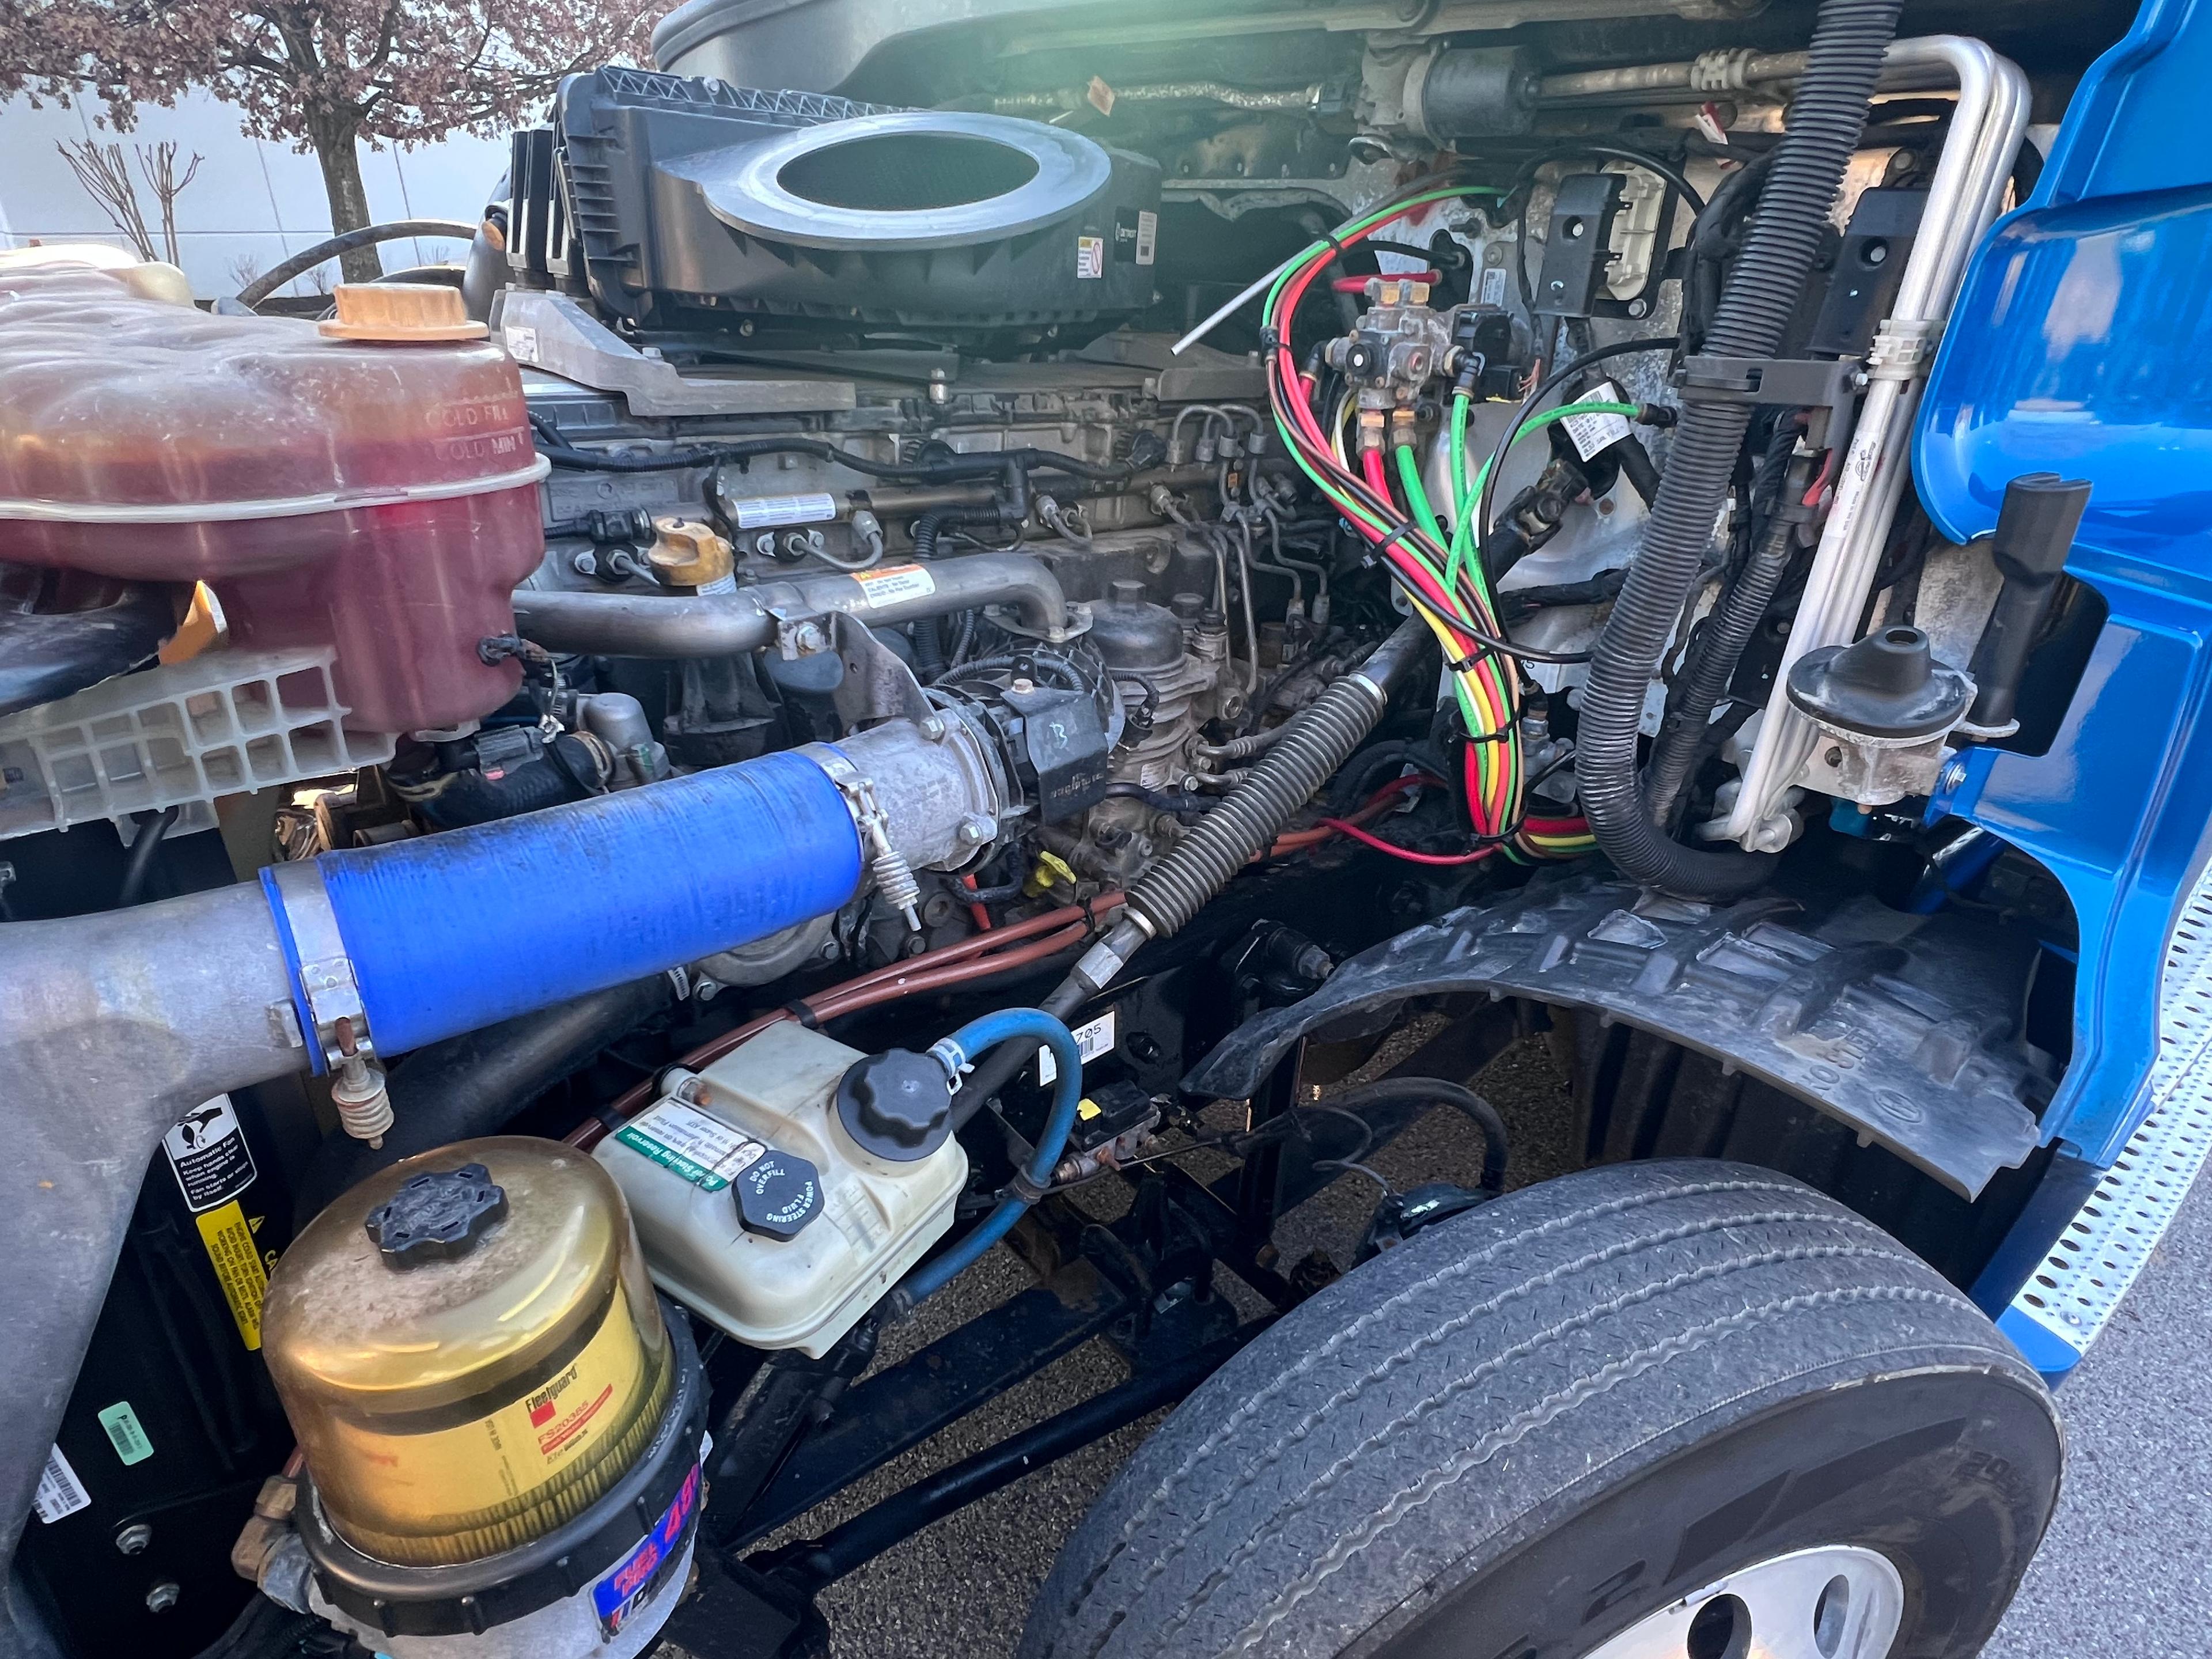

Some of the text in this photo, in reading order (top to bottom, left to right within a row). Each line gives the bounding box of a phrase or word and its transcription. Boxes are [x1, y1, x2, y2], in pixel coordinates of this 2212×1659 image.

[426, 409, 476, 428] COLD
[436, 435, 516, 461] COLD MIN
[180, 1137, 234, 1168] Automatic Fan
[627, 1132, 662, 1155] Reservoir
[749, 1160, 775, 1181] DO NOT
[756, 1168, 785, 1195] OVERFILL
[766, 1180, 813, 1222] POWER STEERING
[781, 1193, 804, 1214] FLUID
[525, 1365, 577, 1413] Fleetguard
